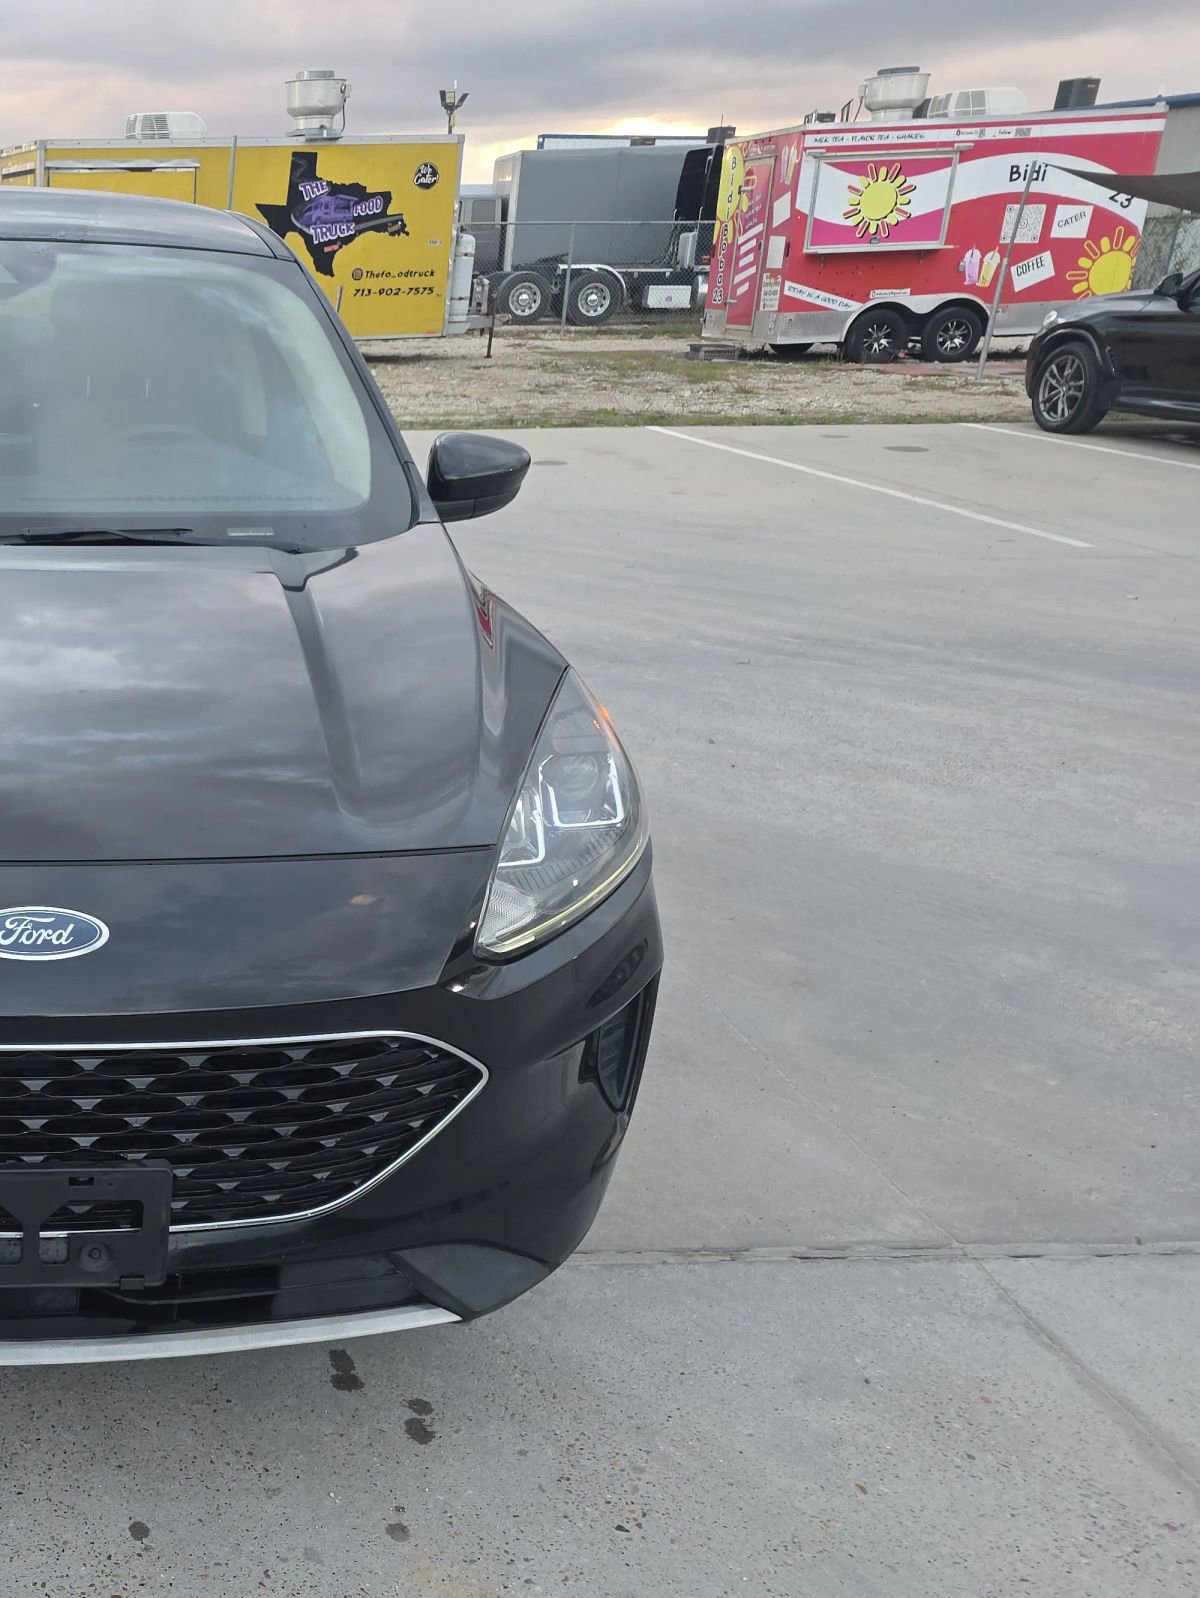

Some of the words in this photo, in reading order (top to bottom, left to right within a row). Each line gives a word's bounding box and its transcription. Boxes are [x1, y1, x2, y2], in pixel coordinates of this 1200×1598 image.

[1009, 164, 1049, 182] Bidi
[299, 180, 329, 201] THE
[353, 195, 383, 216] FOOD
[1057, 210, 1087, 228] CATER
[310, 222, 356, 244] TRUCK
[365, 269, 435, 279] Thefo_odtruck
[1016, 255, 1045, 277] COFFEE
[353, 286, 435, 297] 713-902-7575
